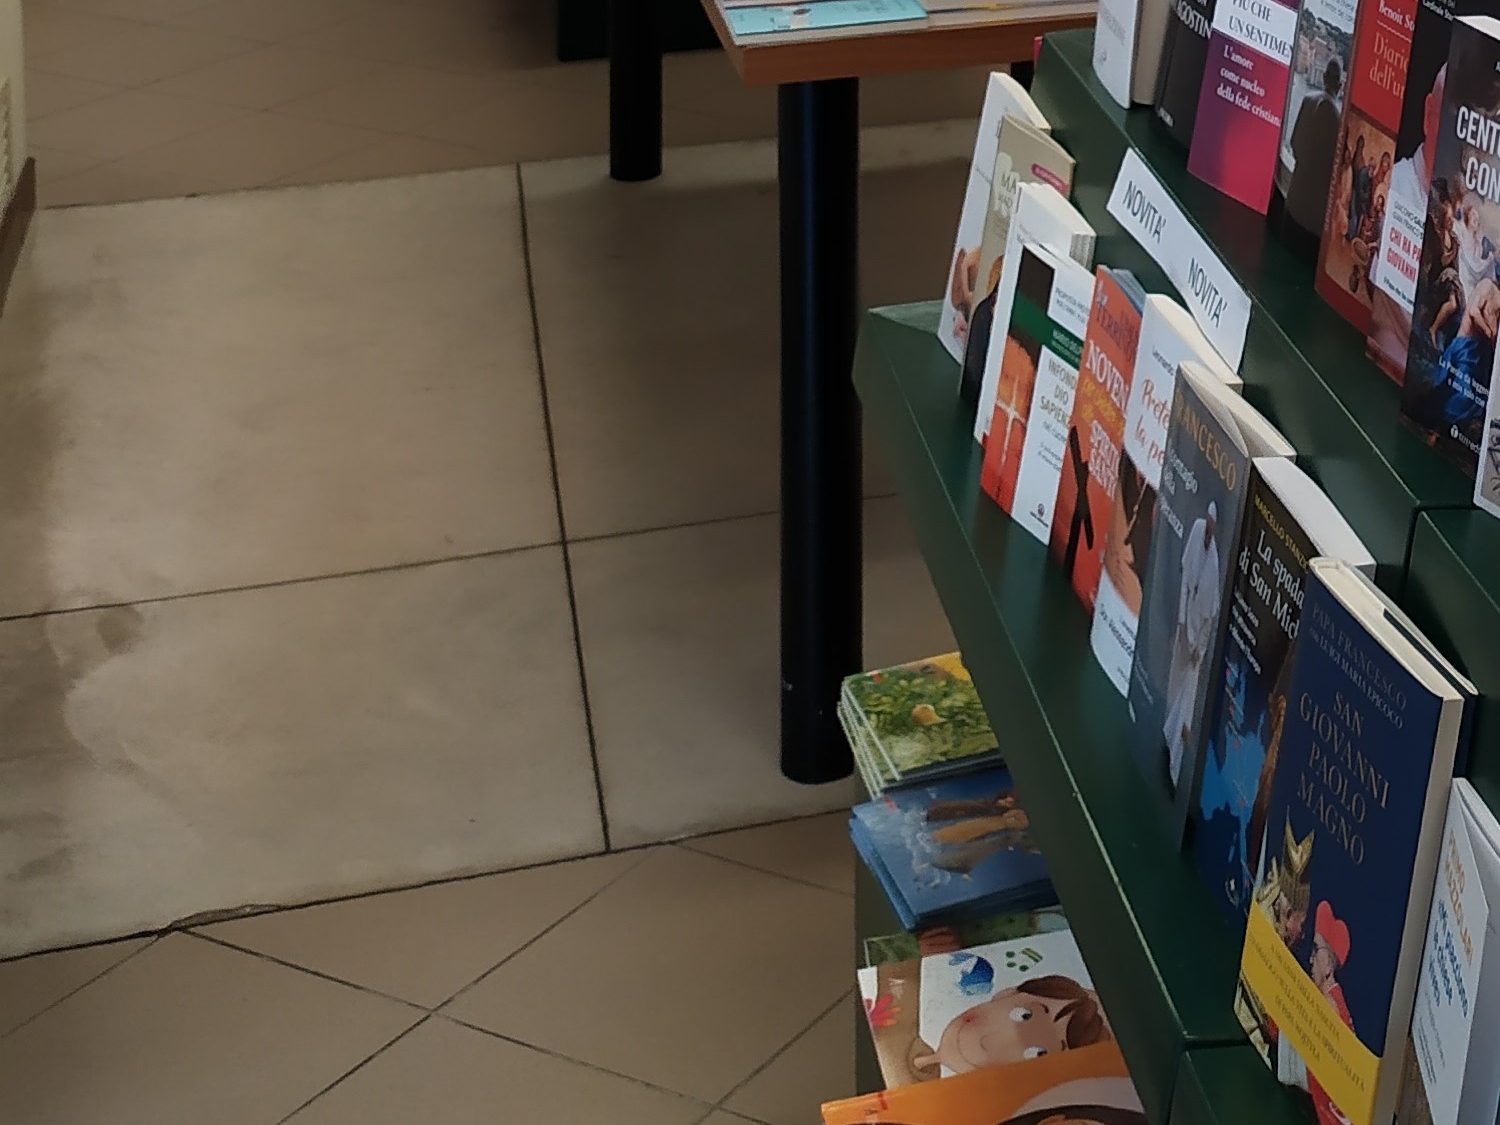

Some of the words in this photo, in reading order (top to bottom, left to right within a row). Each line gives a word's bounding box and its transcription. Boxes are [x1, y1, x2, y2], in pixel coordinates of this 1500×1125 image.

[1229, 16, 1244, 35] UN
[1252, 0, 1271, 22] CHE
[1220, 66, 1239, 85] come
[1240, 74, 1265, 97] nucleo
[1224, 45, 1254, 71] L'amore
[1217, 86, 1235, 104] della
[1235, 92, 1251, 112] fede
[1122, 180, 1167, 244] NOVITA'
[1188, 257, 1228, 329] NOVITA'
[1054, 384, 1069, 406] DIO
[1254, 494, 1284, 541] MARCELLO
[1239, 543, 1249, 576] di
[1249, 564, 1272, 606] San
[1257, 530, 1271, 566] La
[1272, 552, 1304, 610] spada
[1338, 630, 1407, 711] FRANCESCO
[1333, 691, 1363, 738] SAN
[1300, 692, 1389, 809] GIOVANNI
[1309, 741, 1366, 823] PAOLO
[1297, 771, 1365, 865] MAGNO
